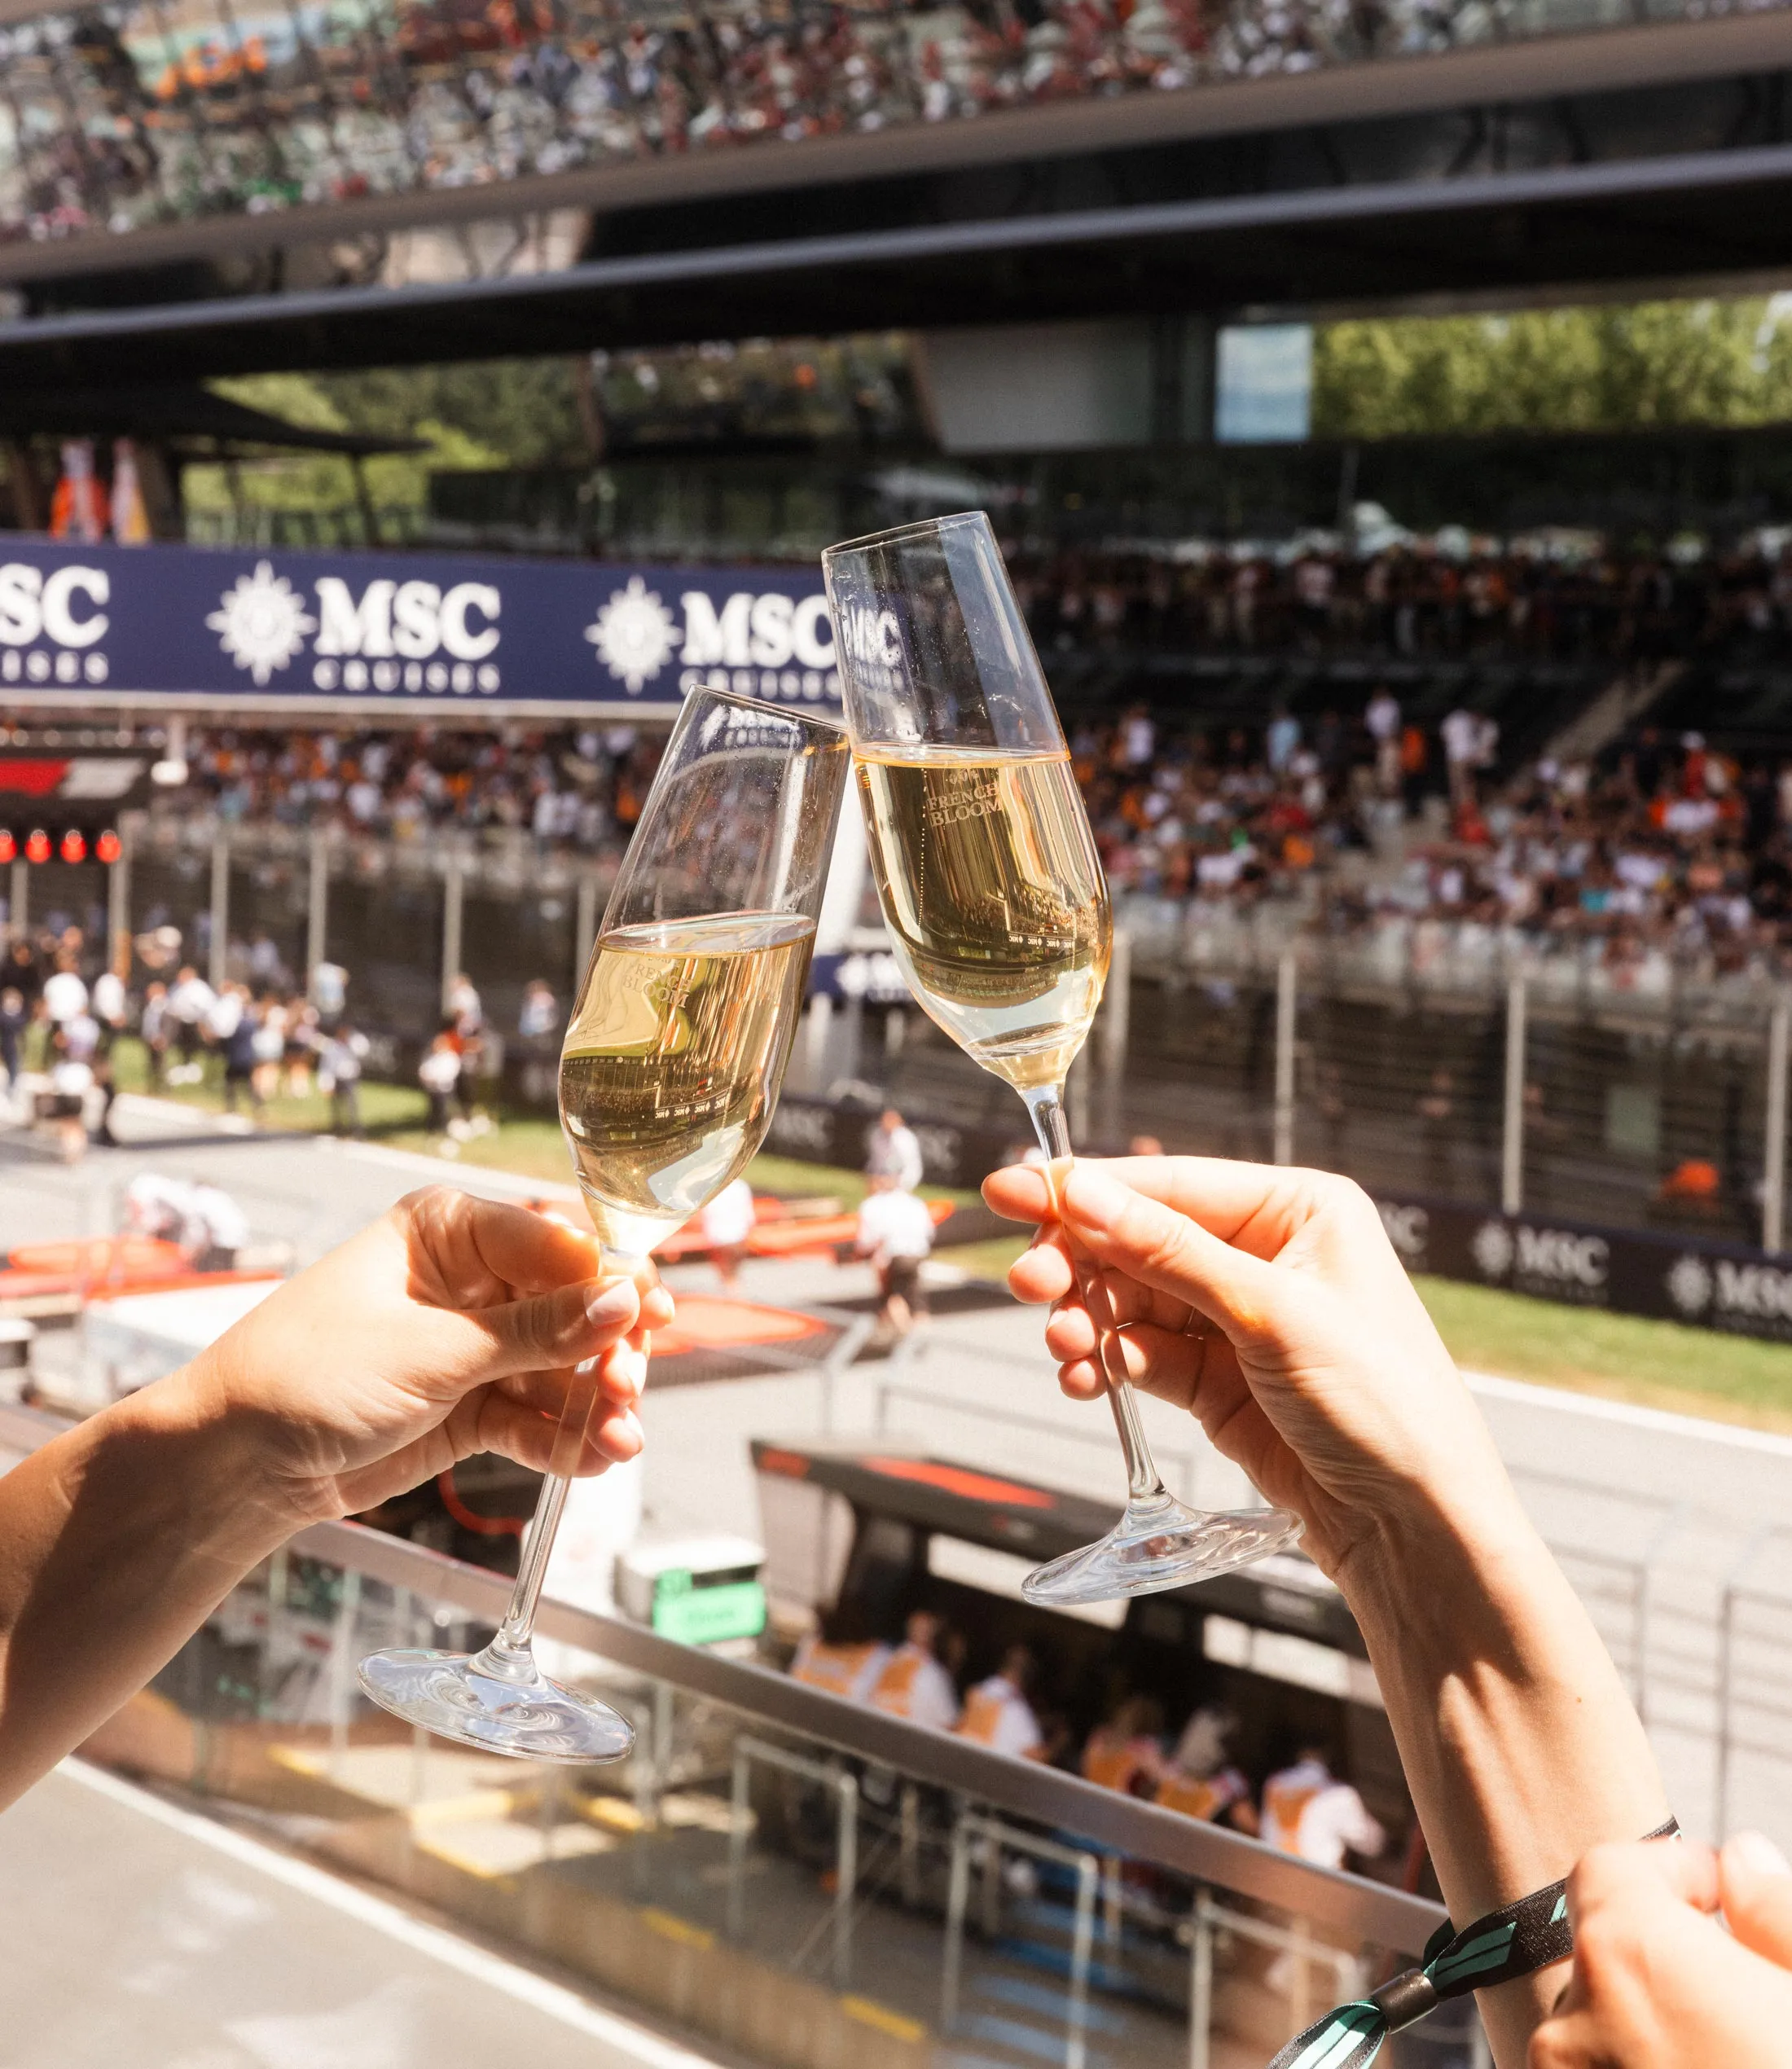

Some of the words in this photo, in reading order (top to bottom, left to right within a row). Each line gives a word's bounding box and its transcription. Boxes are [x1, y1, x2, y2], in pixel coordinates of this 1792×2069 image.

[314, 577, 500, 660] MSC
[926, 780, 999, 811] FRENCH
[929, 797, 1003, 827] BLOOM
[622, 975, 689, 1008] BLOOM
